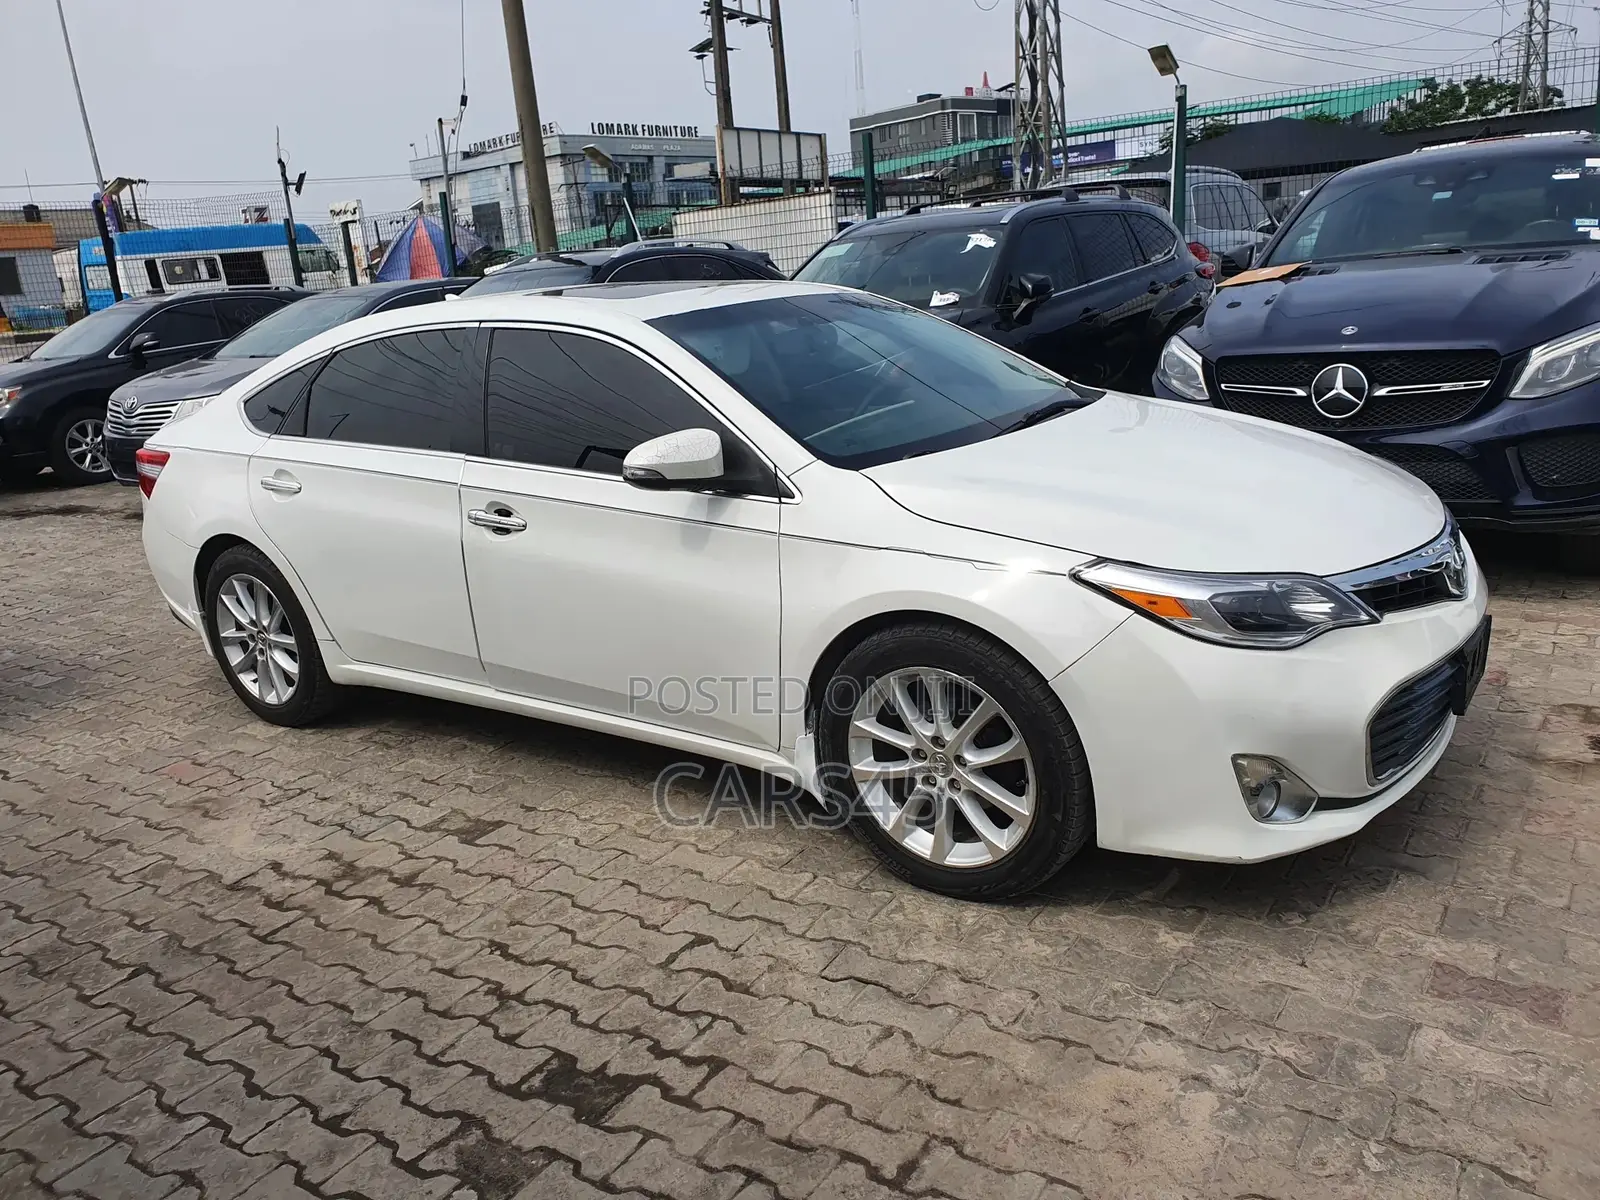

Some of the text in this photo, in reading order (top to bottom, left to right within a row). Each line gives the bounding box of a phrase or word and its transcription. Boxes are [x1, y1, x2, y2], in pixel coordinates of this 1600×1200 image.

[591, 122, 699, 138] LOMARK FURNITURE
[469, 136, 505, 155] LOMARK
